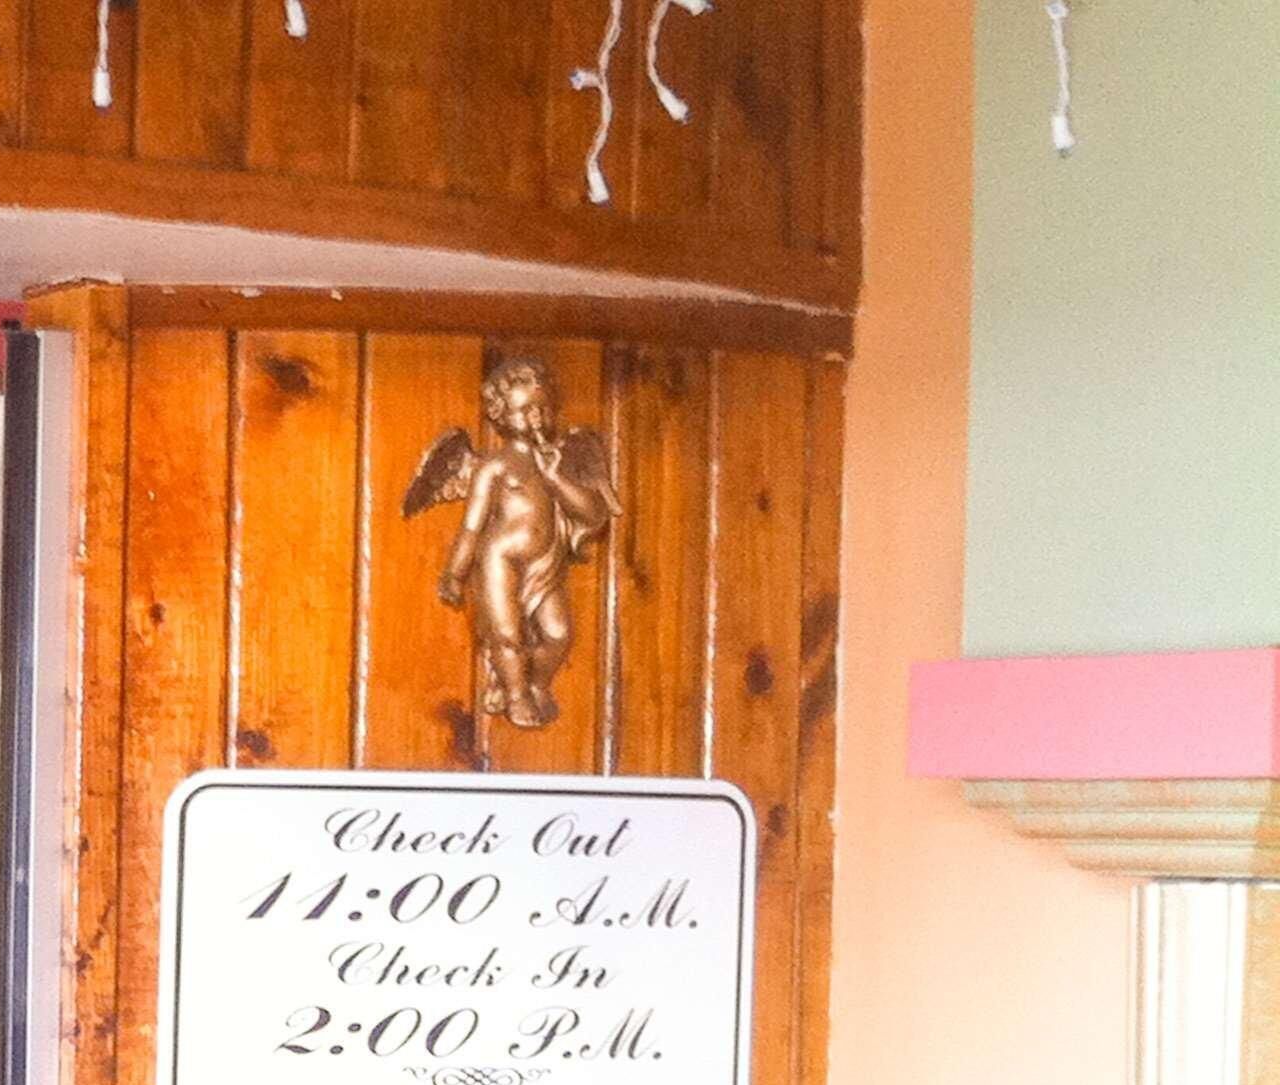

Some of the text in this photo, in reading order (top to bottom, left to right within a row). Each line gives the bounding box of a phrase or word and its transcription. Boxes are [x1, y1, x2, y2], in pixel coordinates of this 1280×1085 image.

[323, 807, 633, 860] Check Out
[240, 872, 700, 930] 11:00 A.M.
[327, 939, 618, 991] Check In
[272, 1005, 664, 1063] 2:00 P.M.
